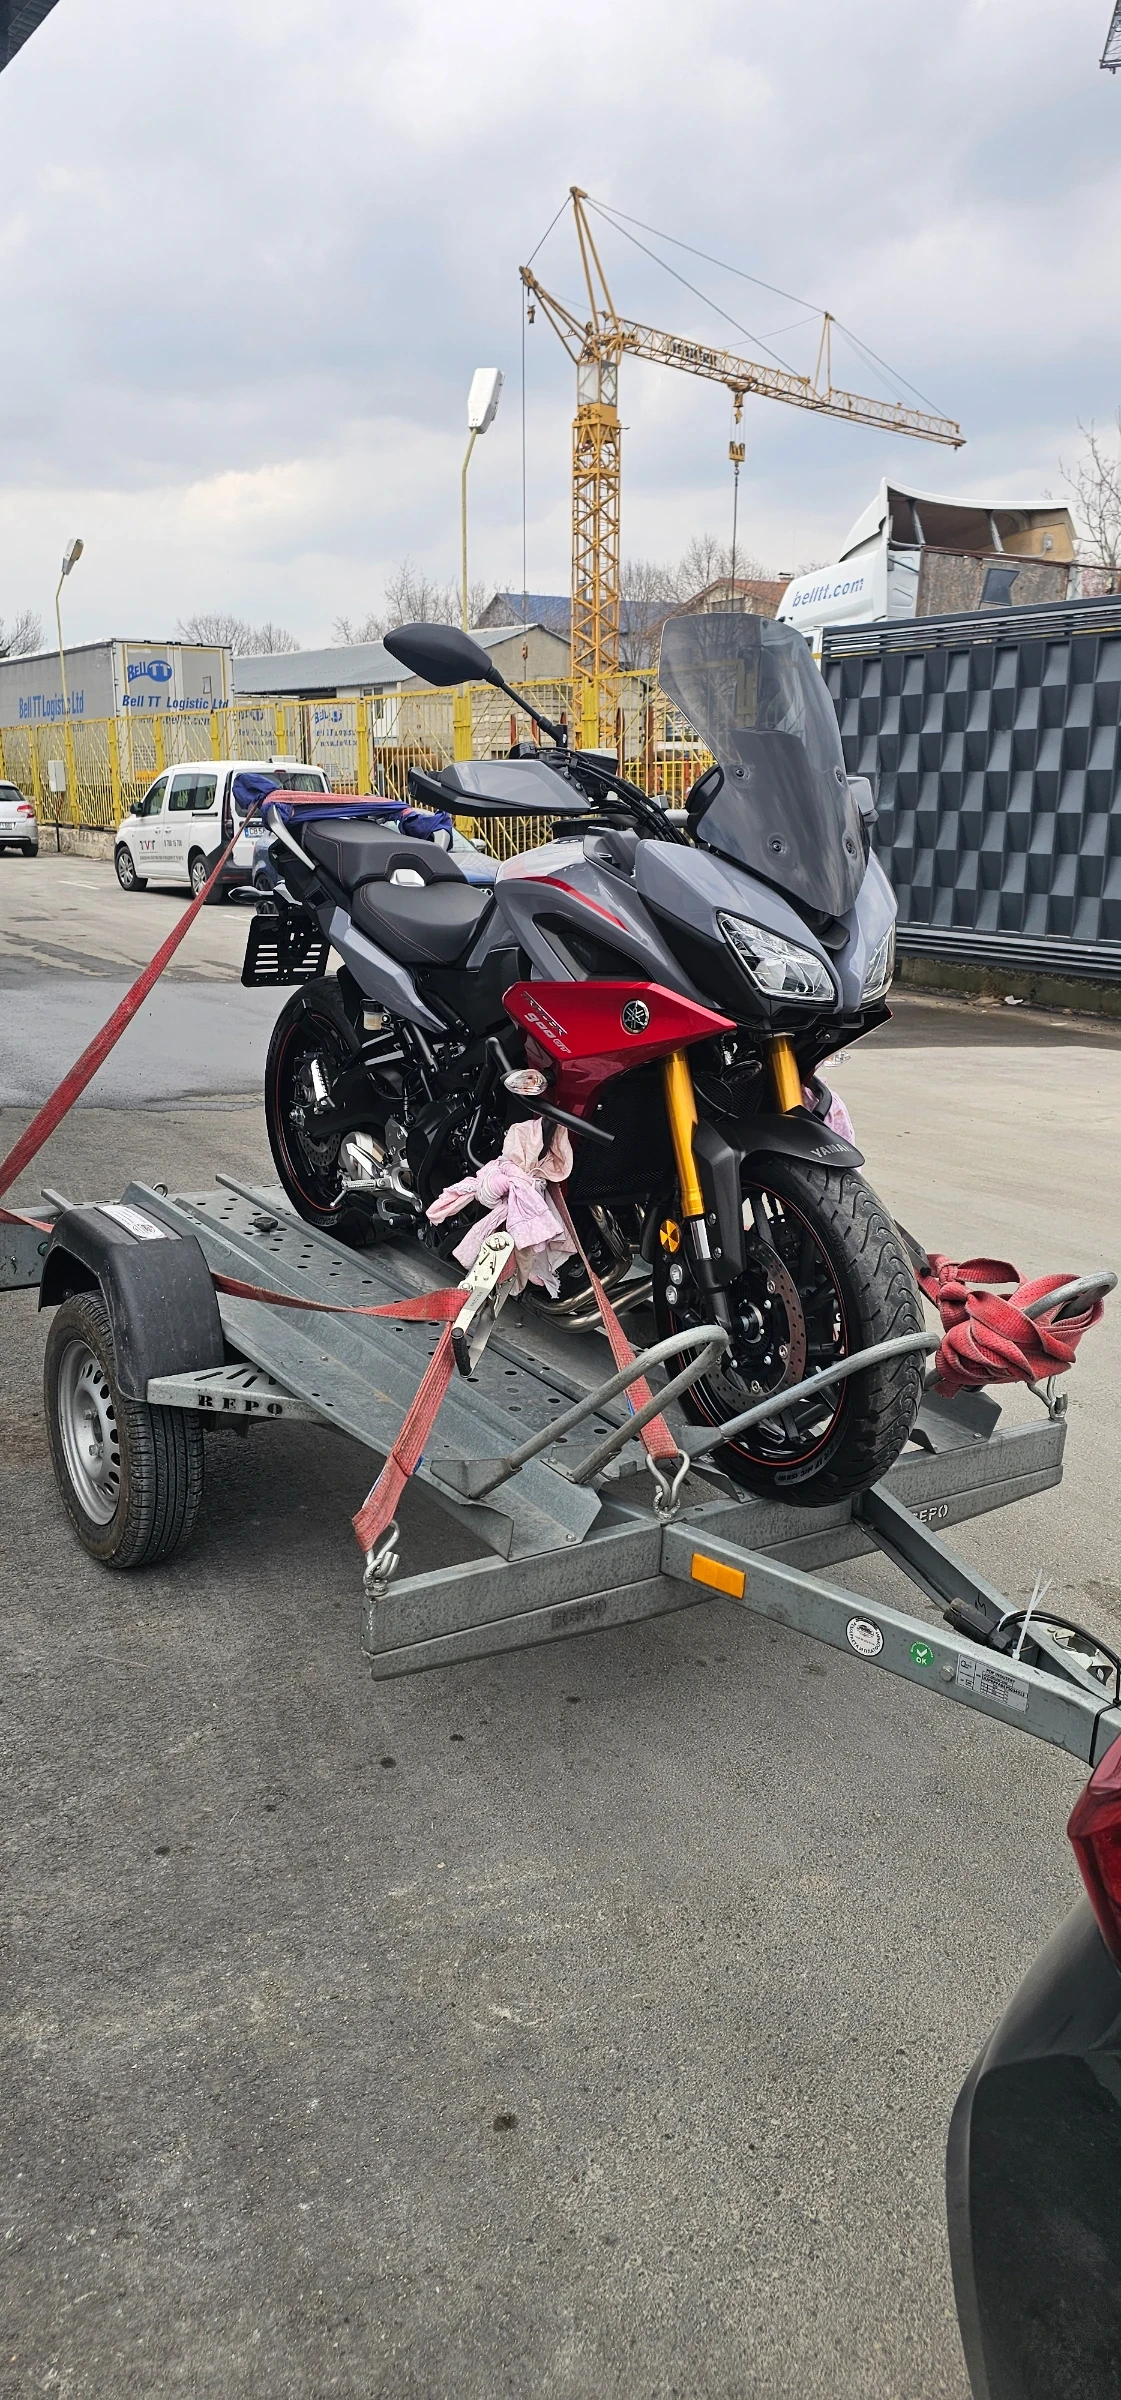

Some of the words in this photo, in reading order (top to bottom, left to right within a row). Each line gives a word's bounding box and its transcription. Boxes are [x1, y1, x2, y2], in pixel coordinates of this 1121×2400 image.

[792, 578, 864, 607] belltt.com
[148, 662, 170, 677] TT
[18, 695, 32, 719] Bell
[32, 694, 41, 718] TT
[71, 689, 84, 714] Ltd
[122, 694, 144, 708] Bell
[148, 696, 162, 708] TT
[166, 696, 209, 711] Logistic
[211, 697, 230, 709] Ltd
[197, 1394, 283, 1415] REPO
[912, 1504, 949, 1523] EPO
[915, 1656, 928, 1665] OK
